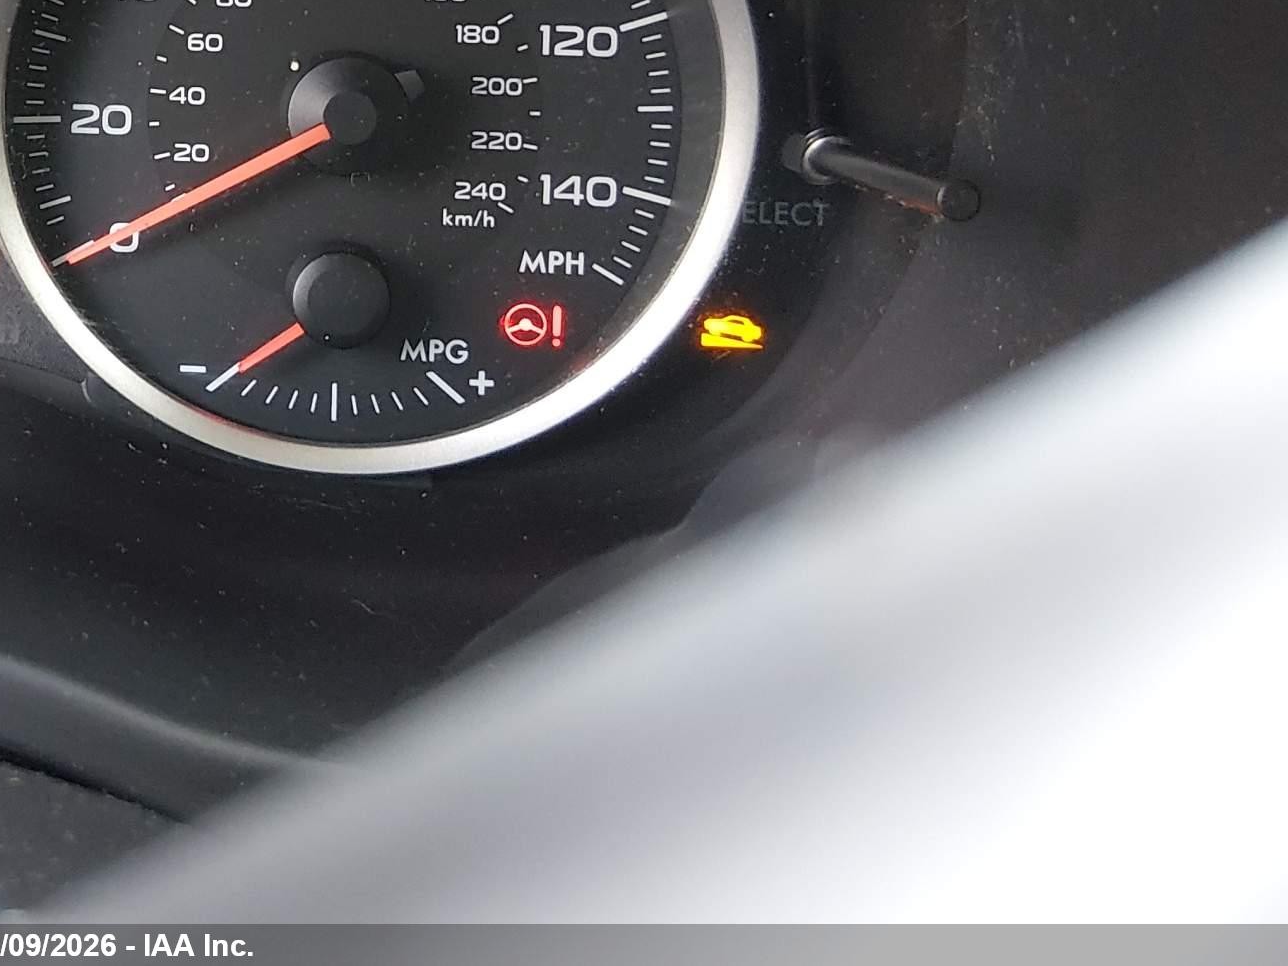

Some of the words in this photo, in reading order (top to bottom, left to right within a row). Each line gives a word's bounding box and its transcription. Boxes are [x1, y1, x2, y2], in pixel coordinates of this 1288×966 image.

[186, 34, 223, 52] 60
[456, 24, 500, 44] 180
[539, 23, 618, 57] 120
[168, 86, 206, 106] 40
[471, 76, 523, 96] 200
[71, 103, 132, 135] 20
[471, 131, 522, 151] 220
[173, 143, 210, 163] 20
[453, 181, 506, 200] 240
[539, 175, 617, 208] 140
[442, 208, 495, 230] km/h
[741, 200, 830, 227] ELECT
[109, 222, 140, 253] 0
[519, 250, 585, 276] MPH
[400, 339, 469, 365] MPG
